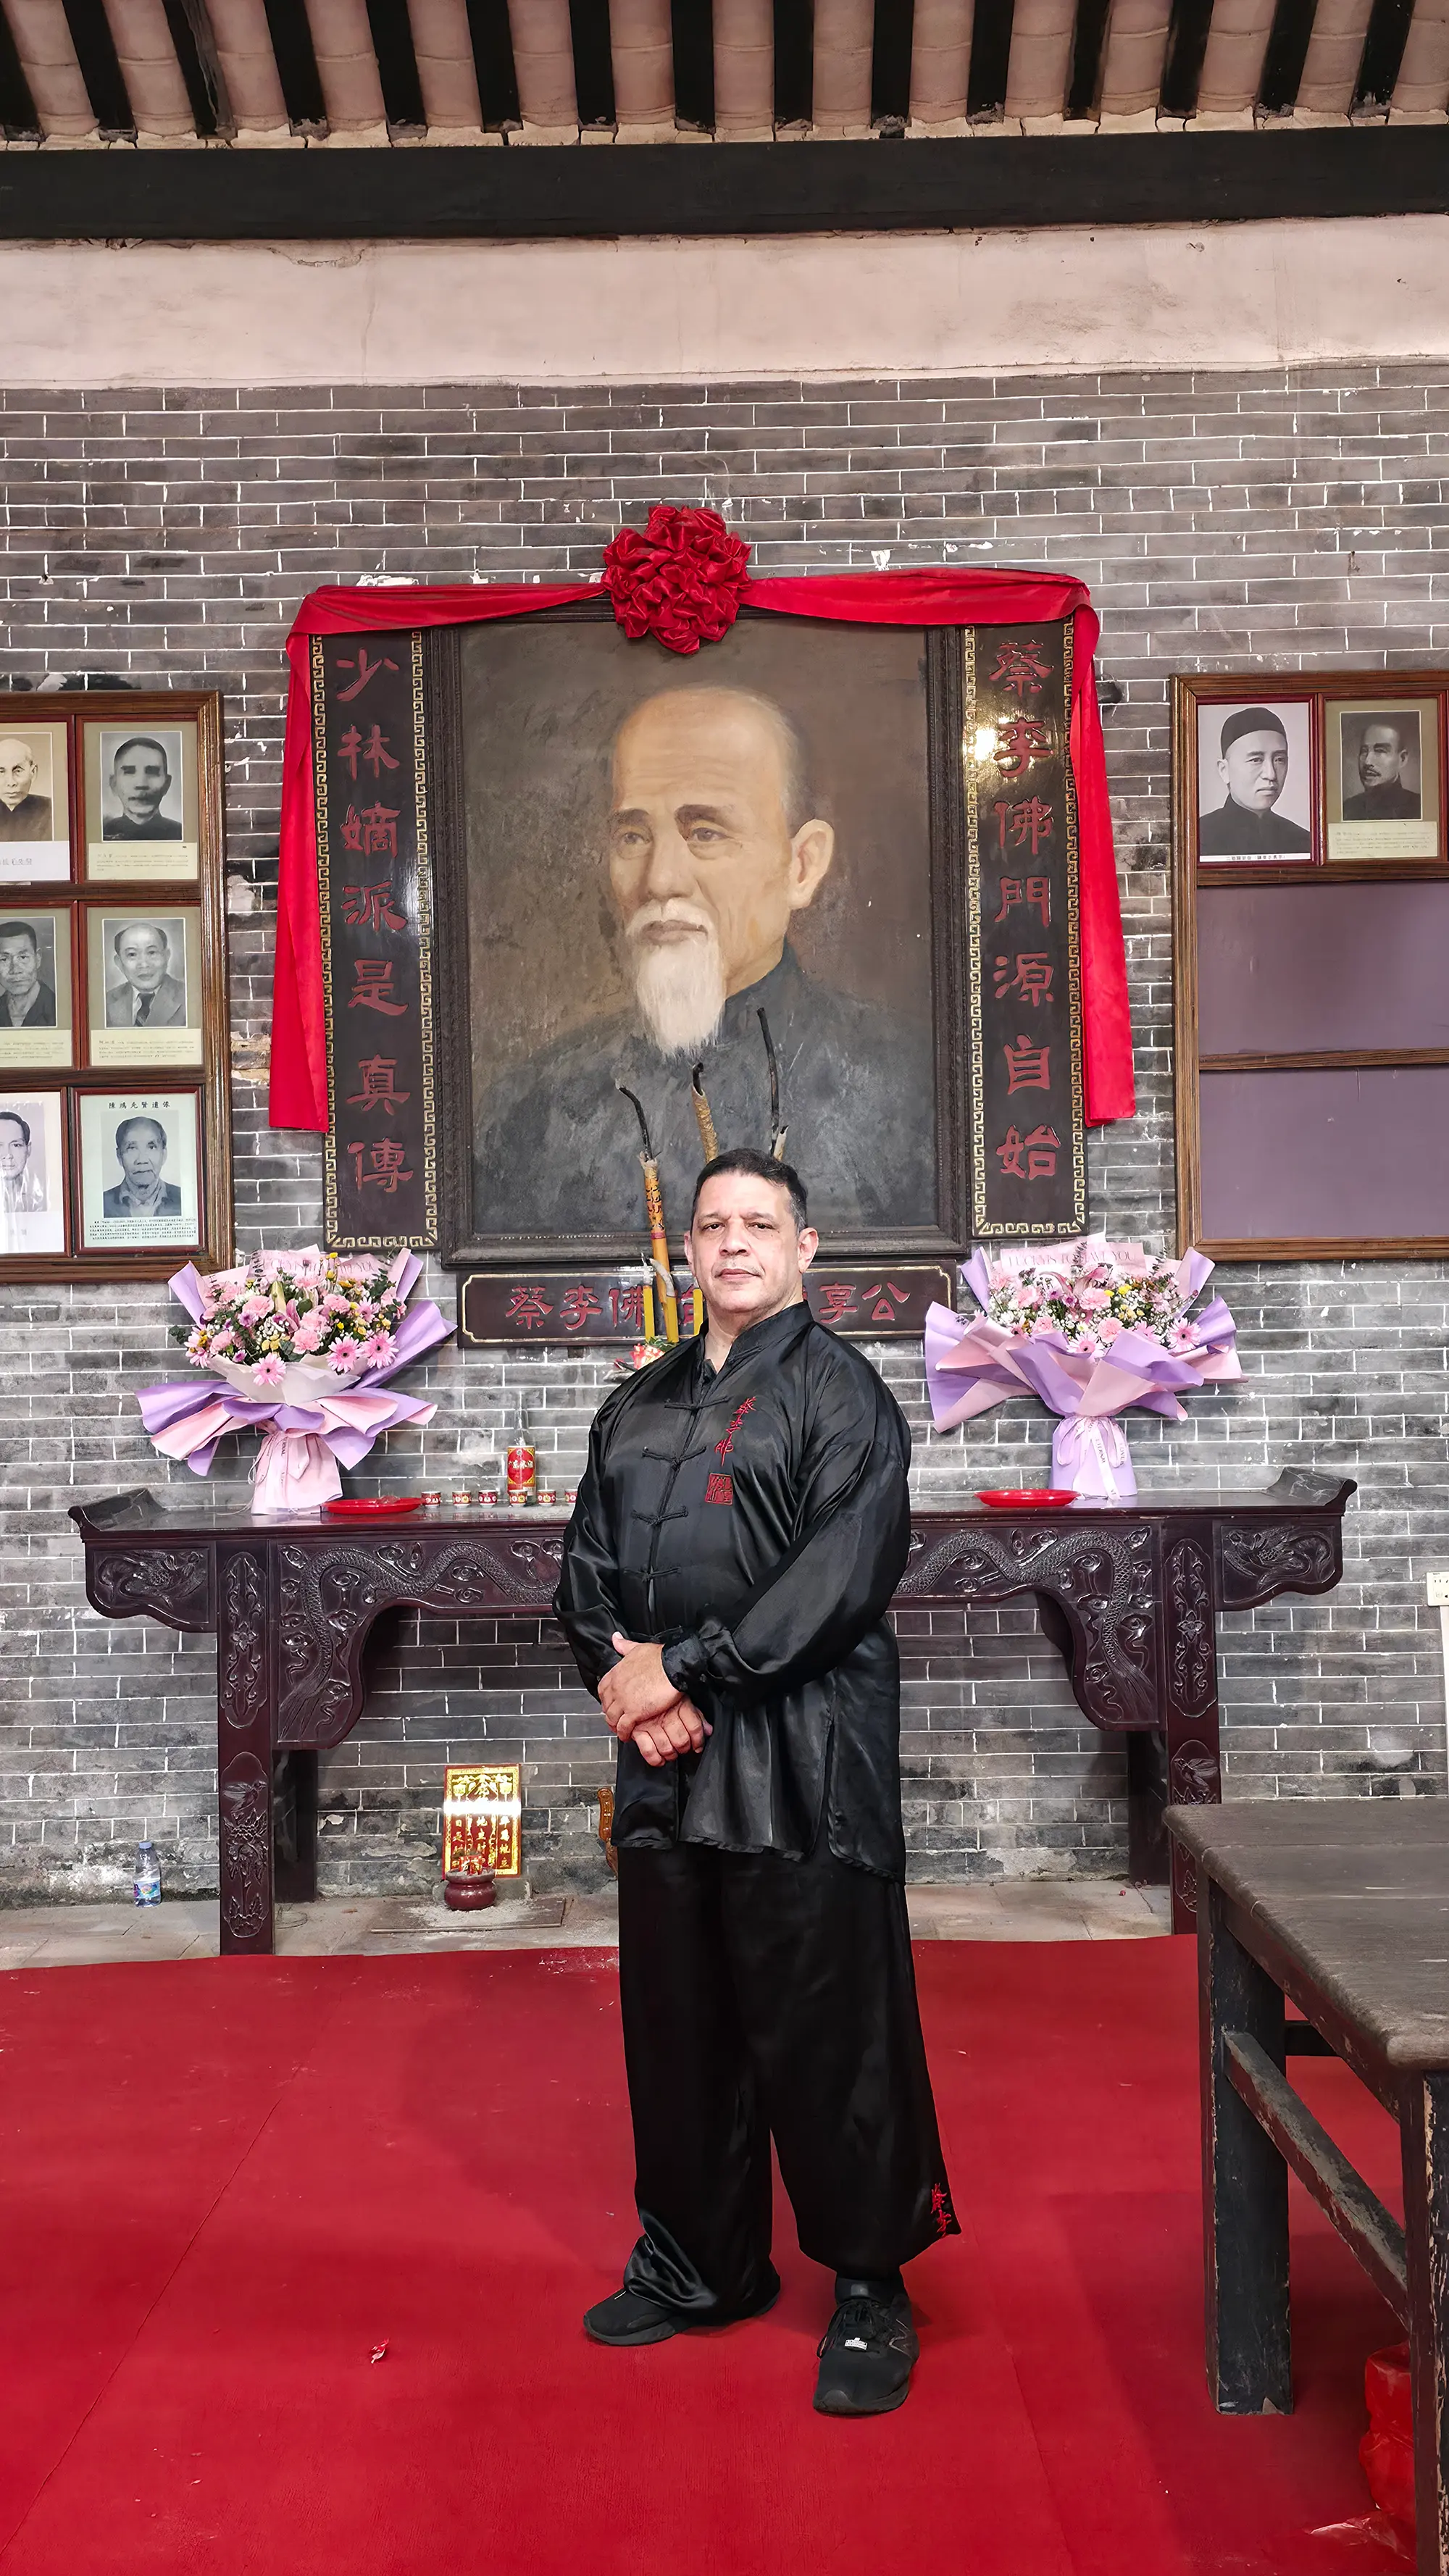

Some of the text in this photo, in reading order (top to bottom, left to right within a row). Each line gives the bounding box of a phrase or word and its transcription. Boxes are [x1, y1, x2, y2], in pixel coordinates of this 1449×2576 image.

[336, 645, 414, 1194] 少林嫡派是真傳
[988, 639, 1061, 1182] 蔡李佛門源自始
[505, 1281, 911, 1331] 蔡李佛享公
